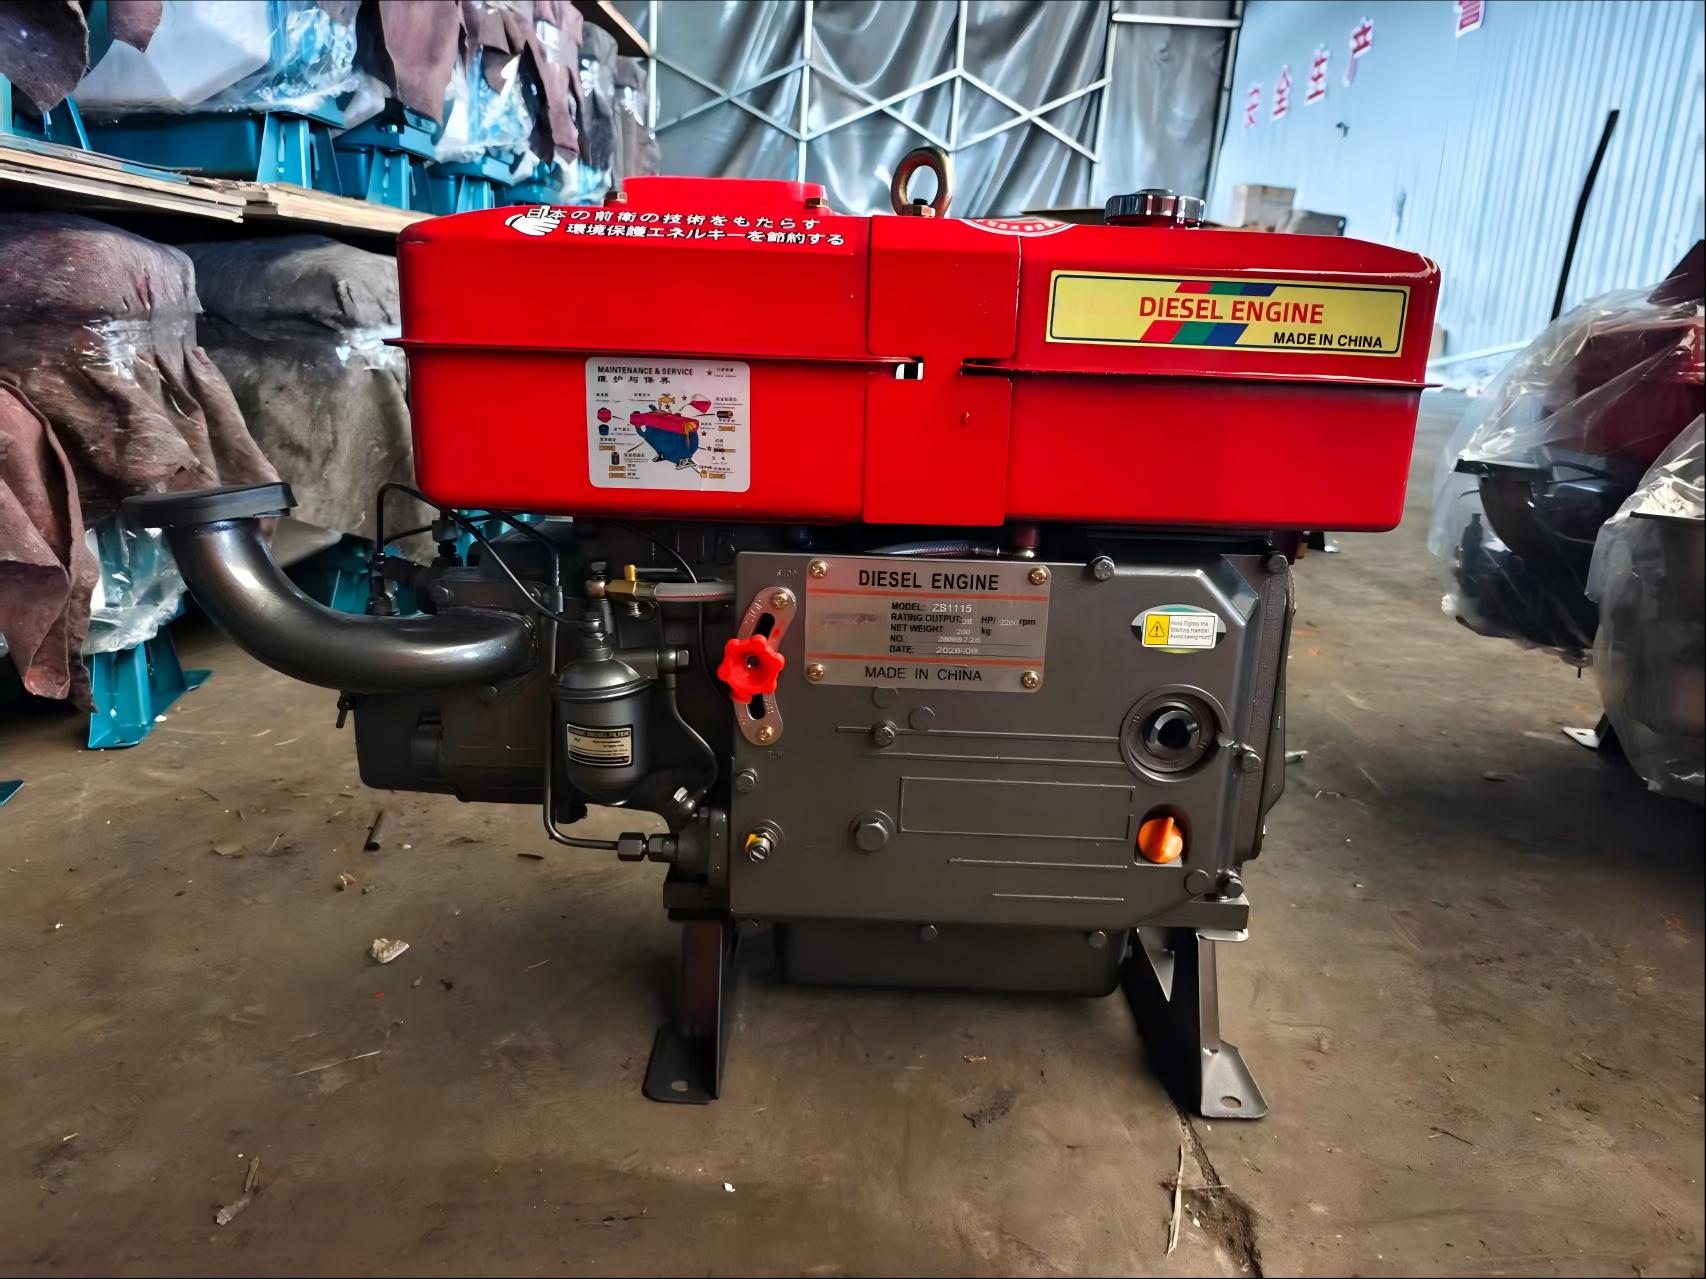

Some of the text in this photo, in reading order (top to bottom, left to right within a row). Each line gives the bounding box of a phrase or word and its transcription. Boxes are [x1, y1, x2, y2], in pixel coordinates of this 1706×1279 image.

[1139, 296, 1325, 325] DIESEL ENGINE
[1273, 332, 1383, 349] MADE IN CHINA
[597, 366, 653, 376] MAINTENANCE
[662, 368, 694, 376] SERVICE
[859, 569, 999, 591] DIESEL ENGINE
[891, 602, 926, 611] MODEL:
[891, 613, 923, 622] RATING
[925, 615, 963, 624] OUTPUT:
[1019, 619, 1036, 627] rpm
[890, 624, 908, 632] NET
[981, 626, 992, 636] kg
[865, 666, 983, 682] MADE IN CHINA
